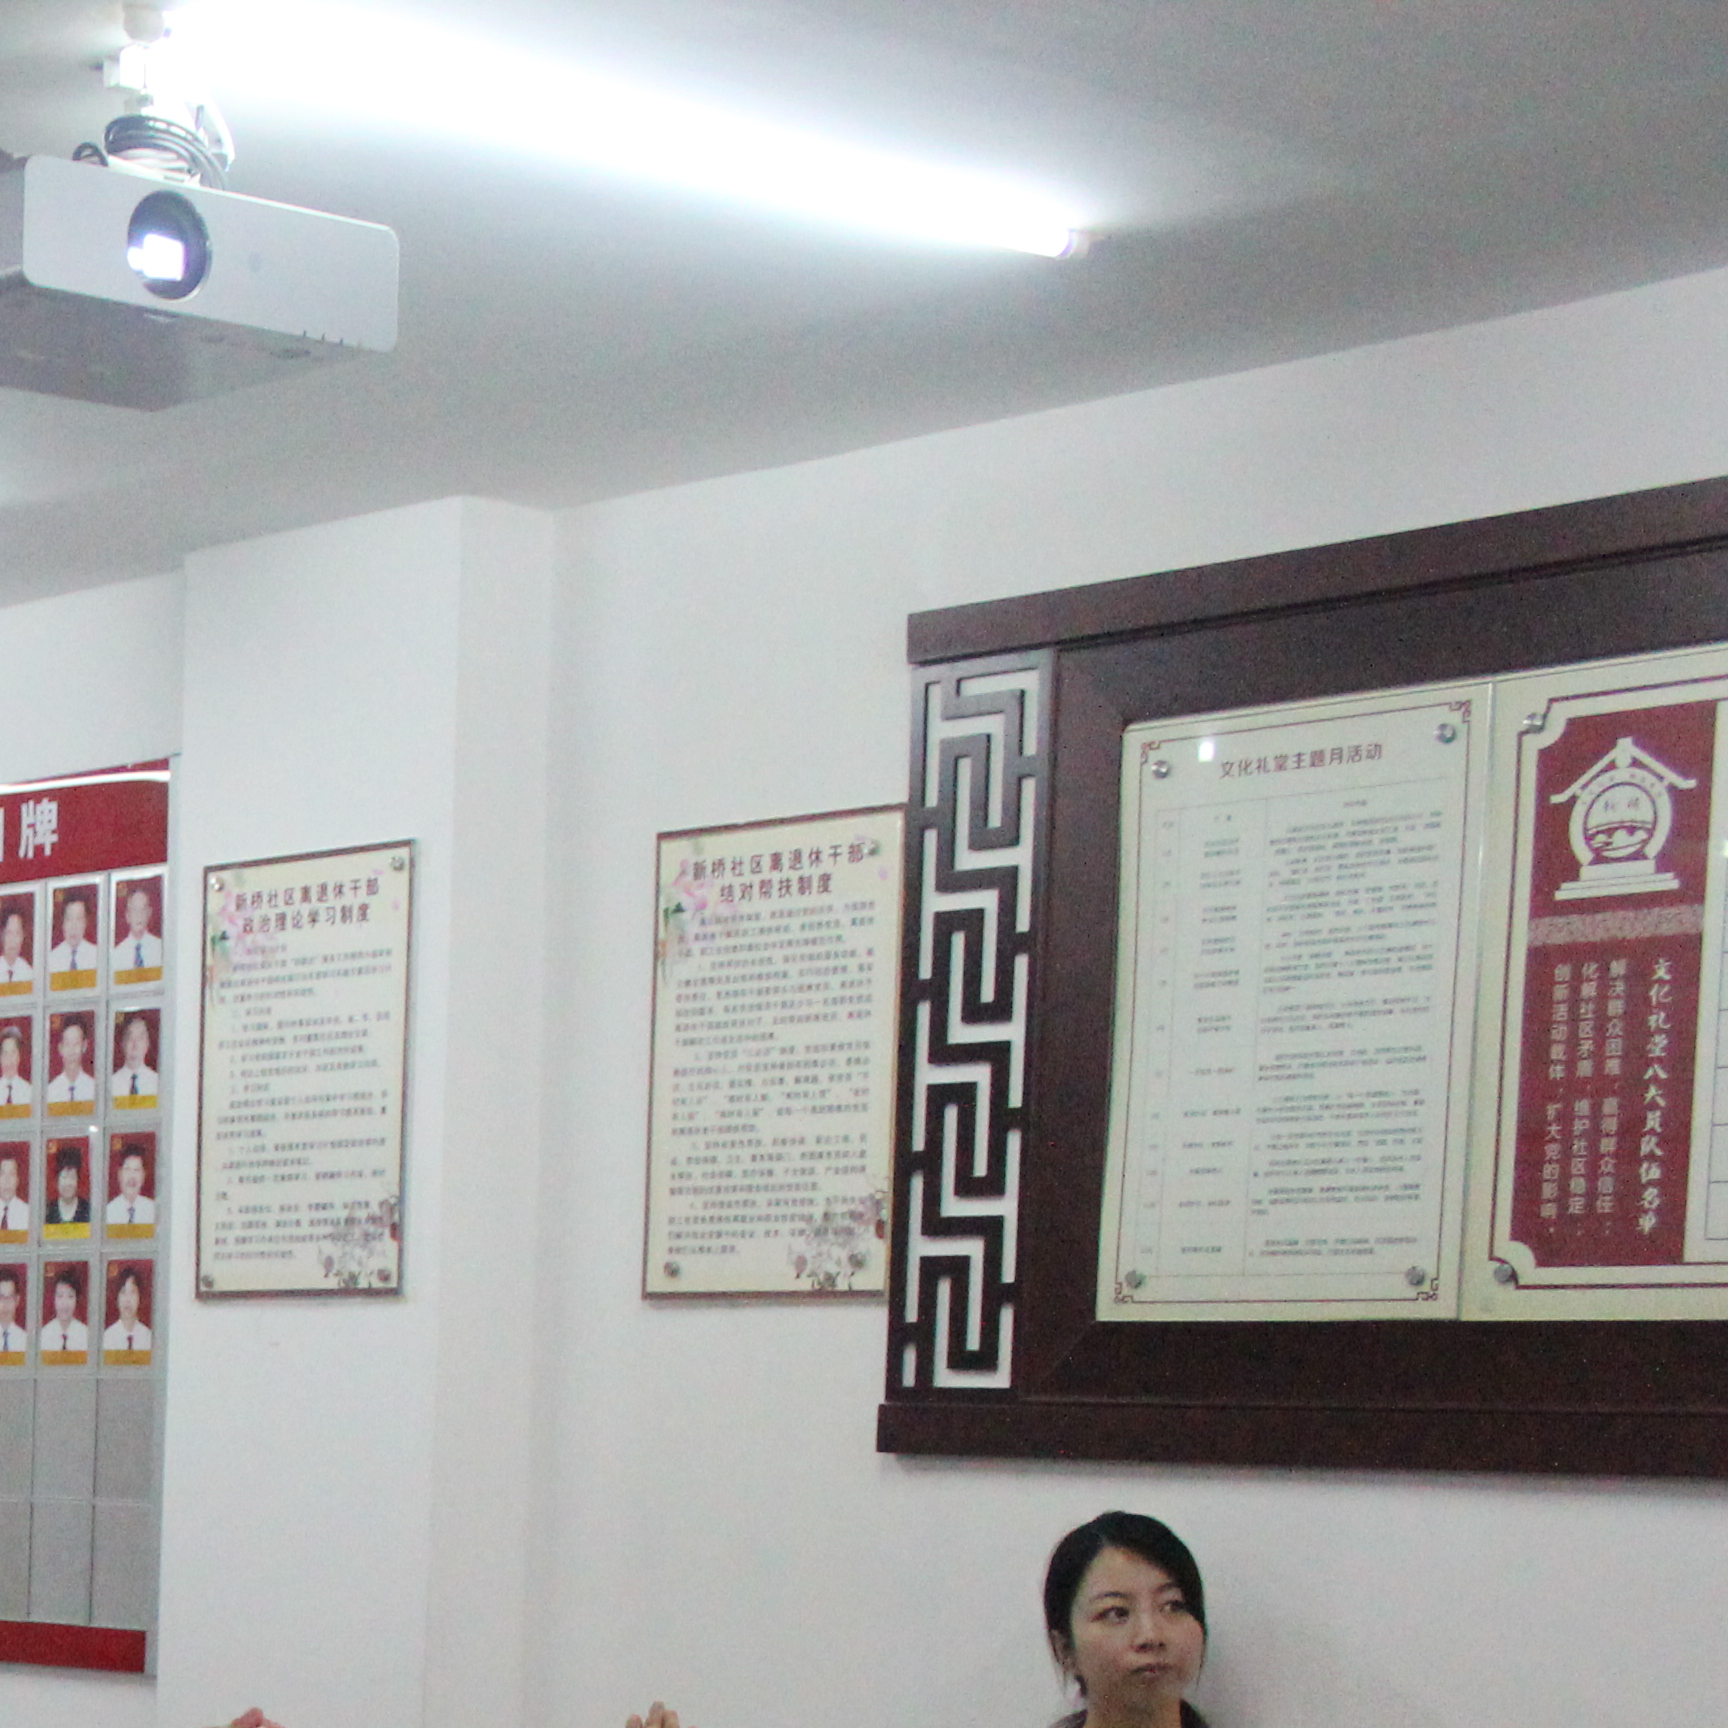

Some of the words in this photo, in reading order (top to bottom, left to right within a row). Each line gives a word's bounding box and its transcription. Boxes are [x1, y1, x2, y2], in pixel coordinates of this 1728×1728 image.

[1219, 743, 1383, 779] 文化礼堂主题月活动
[692, 841, 865, 881] 新桥社区离退休干部
[234, 876, 380, 912] 新桥社区离退休干部
[242, 902, 371, 934] 政治理论学习制度
